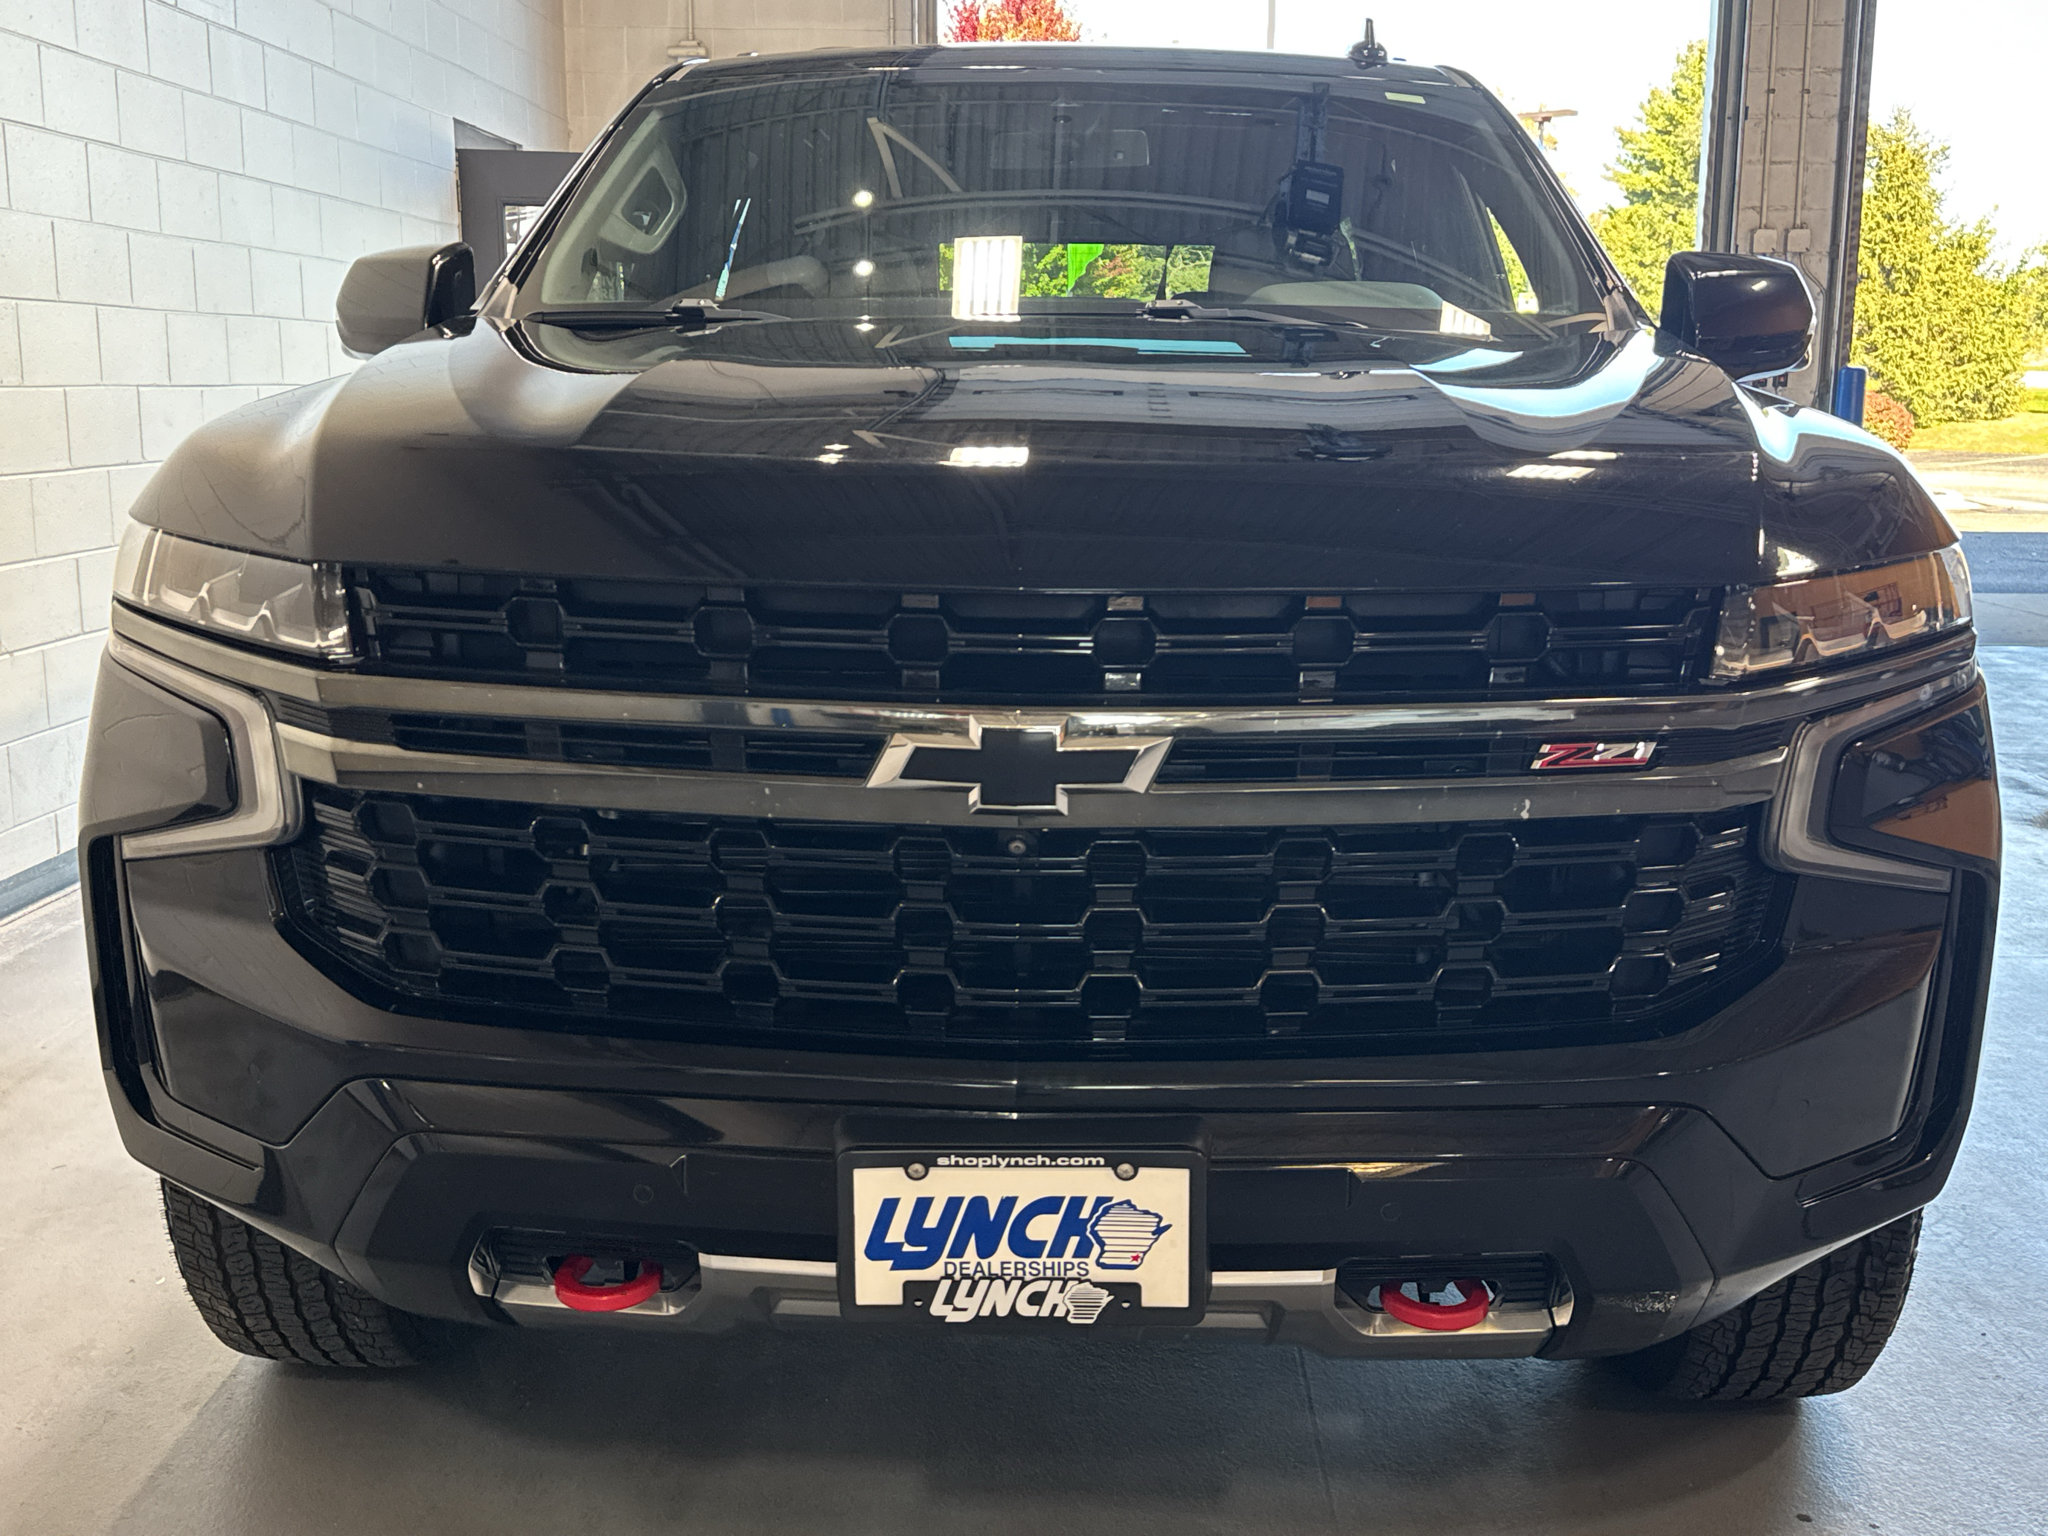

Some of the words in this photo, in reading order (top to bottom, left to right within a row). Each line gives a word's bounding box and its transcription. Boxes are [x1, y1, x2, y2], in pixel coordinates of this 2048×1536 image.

[1530, 741, 1657, 770] Z71
[936, 1154, 1105, 1168] shoplynch.com
[864, 1195, 1114, 1271] LYNCH
[944, 1261, 1090, 1277] DEALERSHIPS
[929, 1279, 1080, 1323] LYNCH
